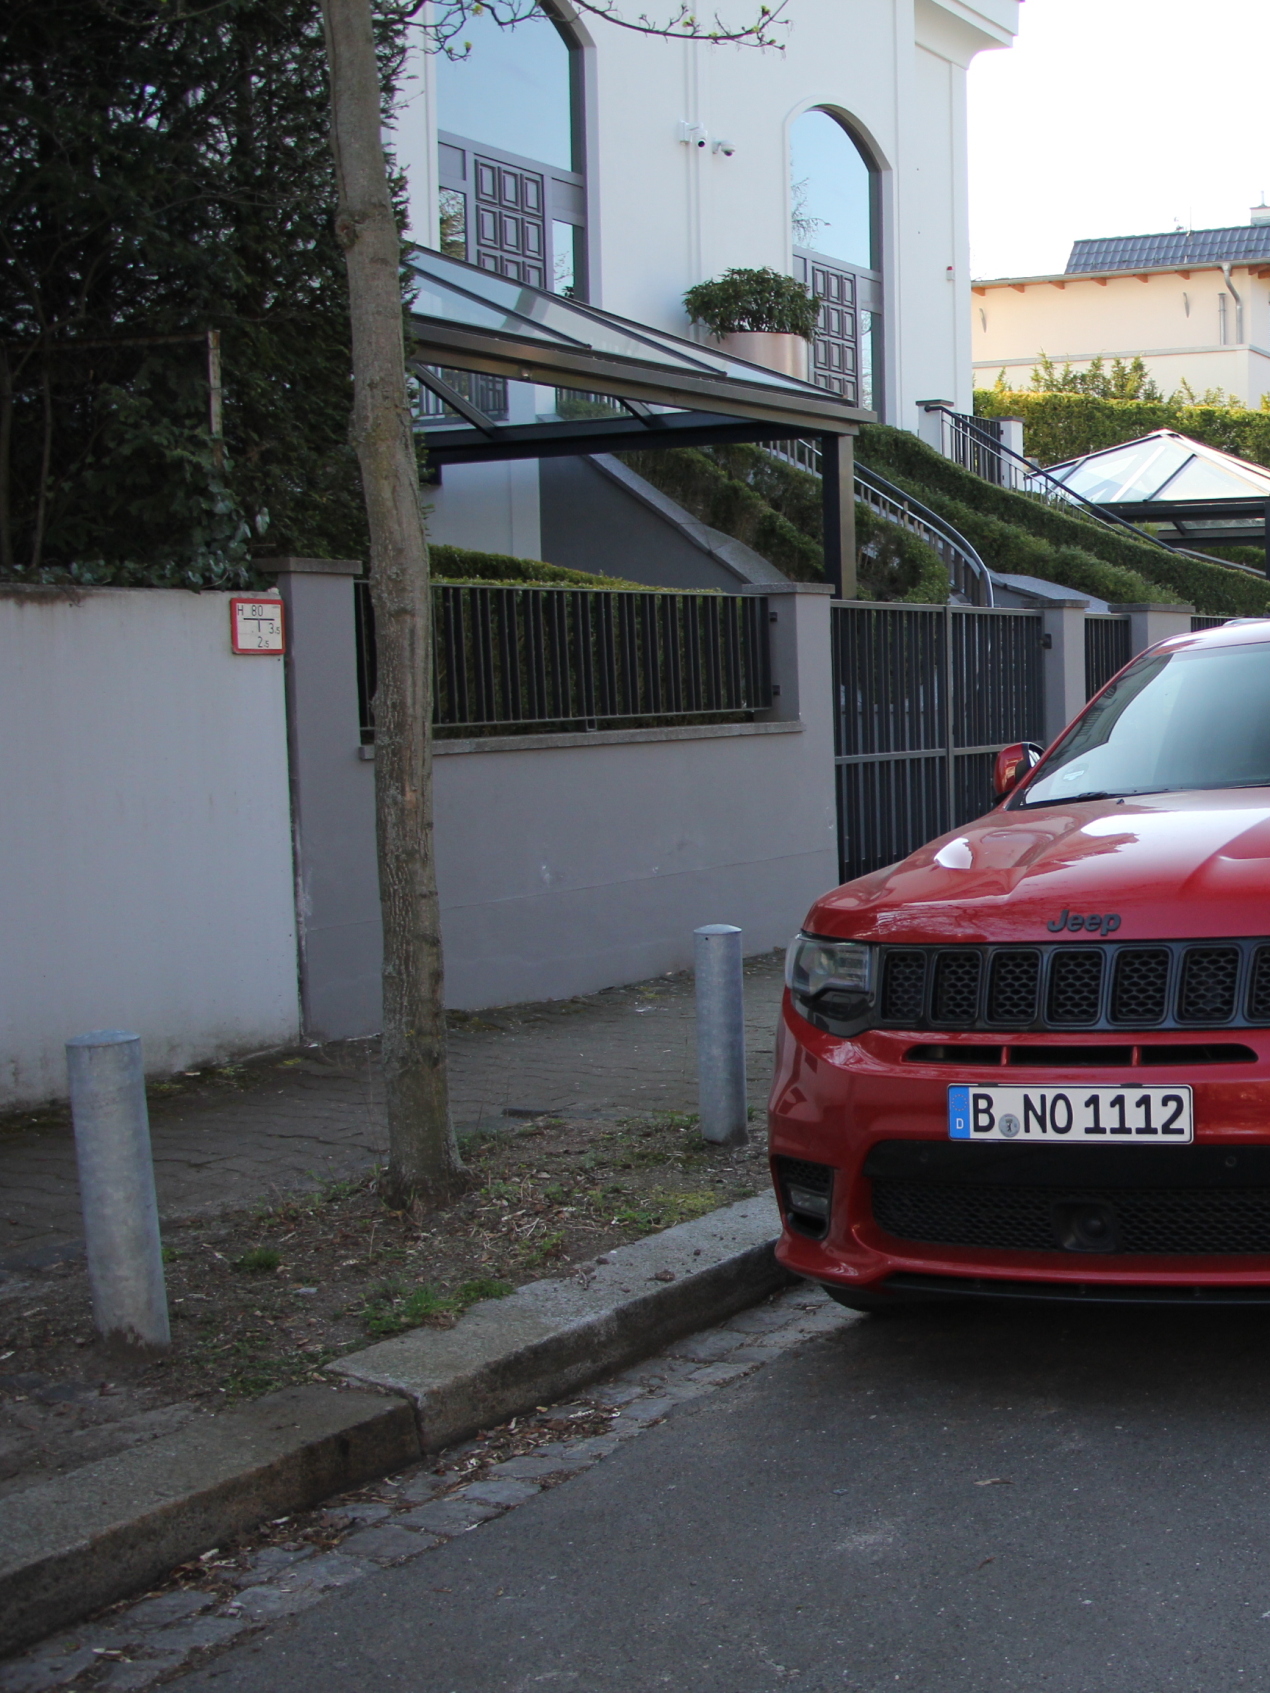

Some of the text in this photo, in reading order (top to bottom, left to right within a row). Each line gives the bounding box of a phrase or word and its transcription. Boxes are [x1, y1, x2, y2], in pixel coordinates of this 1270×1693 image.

[237, 605, 244, 616] H
[251, 605, 264, 617] 80
[1047, 909, 1122, 937] Jeep
[955, 1118, 964, 1130] D
[972, 1093, 1185, 1135] B NO 1112
